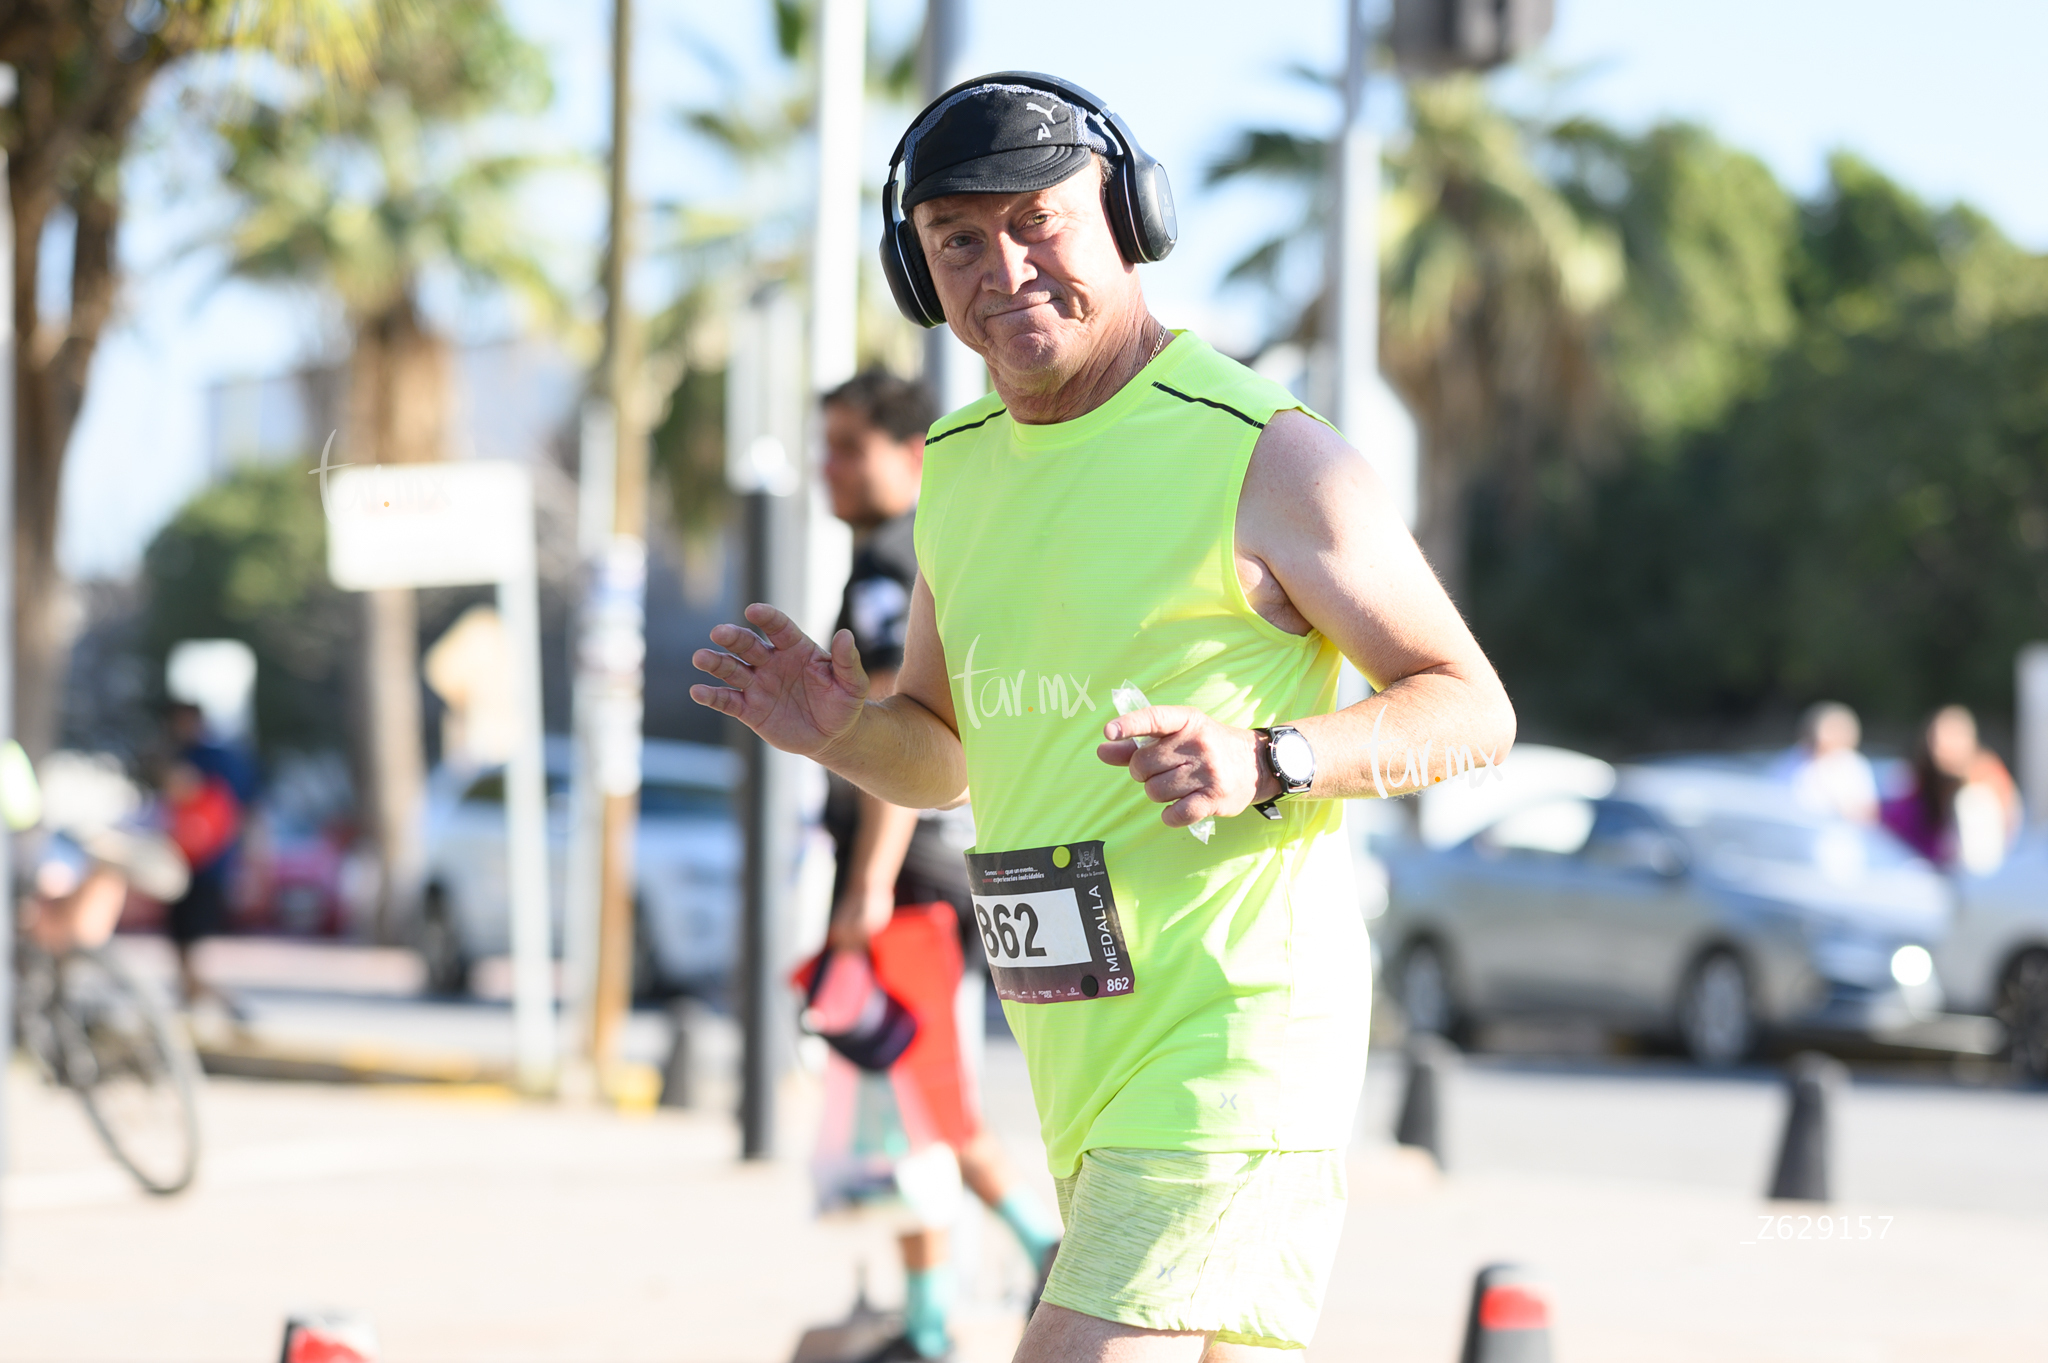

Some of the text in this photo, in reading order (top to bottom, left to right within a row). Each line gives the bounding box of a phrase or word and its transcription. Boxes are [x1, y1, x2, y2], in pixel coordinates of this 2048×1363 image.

[975, 902, 1048, 959] 862
[1088, 885, 1121, 973] MEDALLA
[1106, 976, 1130, 992] 862
